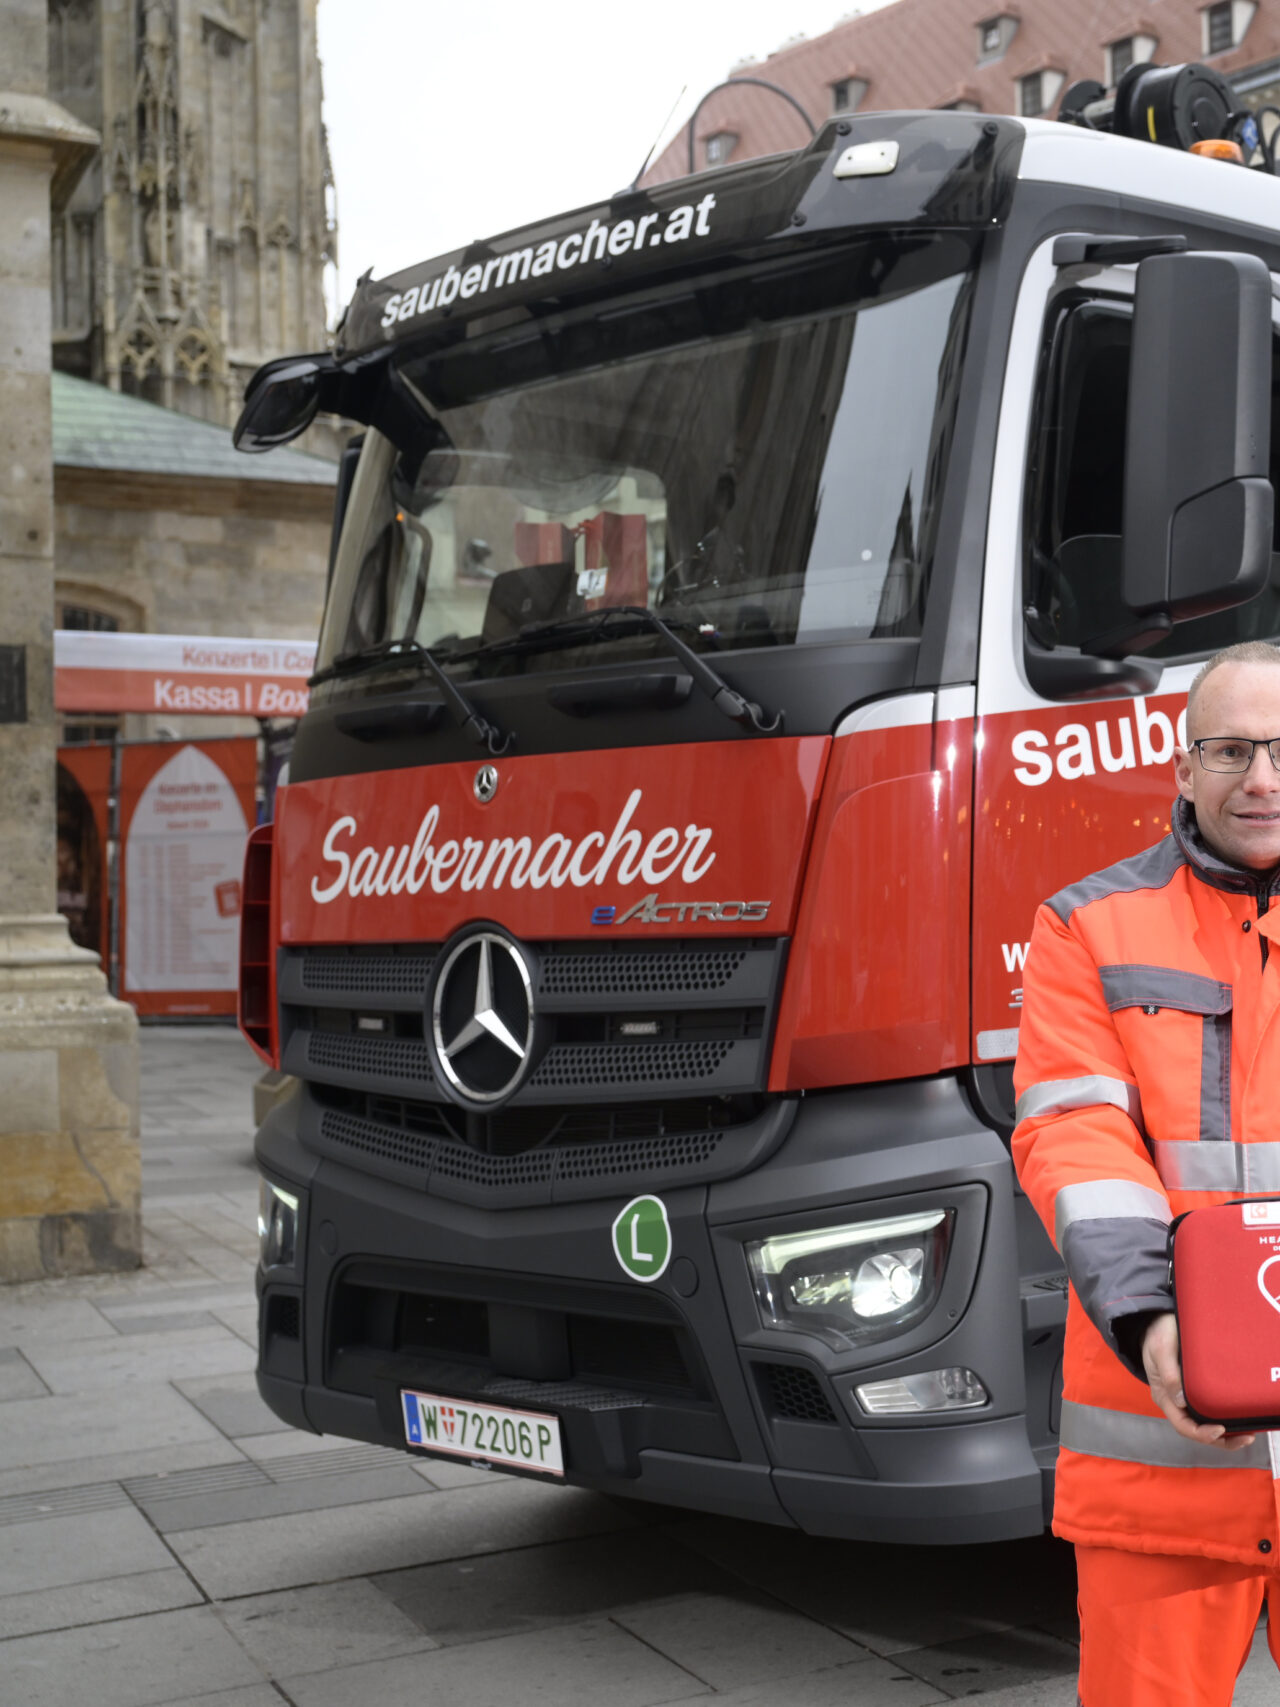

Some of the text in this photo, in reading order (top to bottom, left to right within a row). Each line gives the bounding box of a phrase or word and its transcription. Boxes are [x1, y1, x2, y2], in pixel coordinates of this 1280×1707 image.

[381, 193, 716, 328] saubermacher.at
[182, 646, 269, 669] Konzerte
[154, 678, 311, 713] Kassa Box
[311, 788, 717, 904] Saubermacher
[630, 1213, 653, 1263] L
